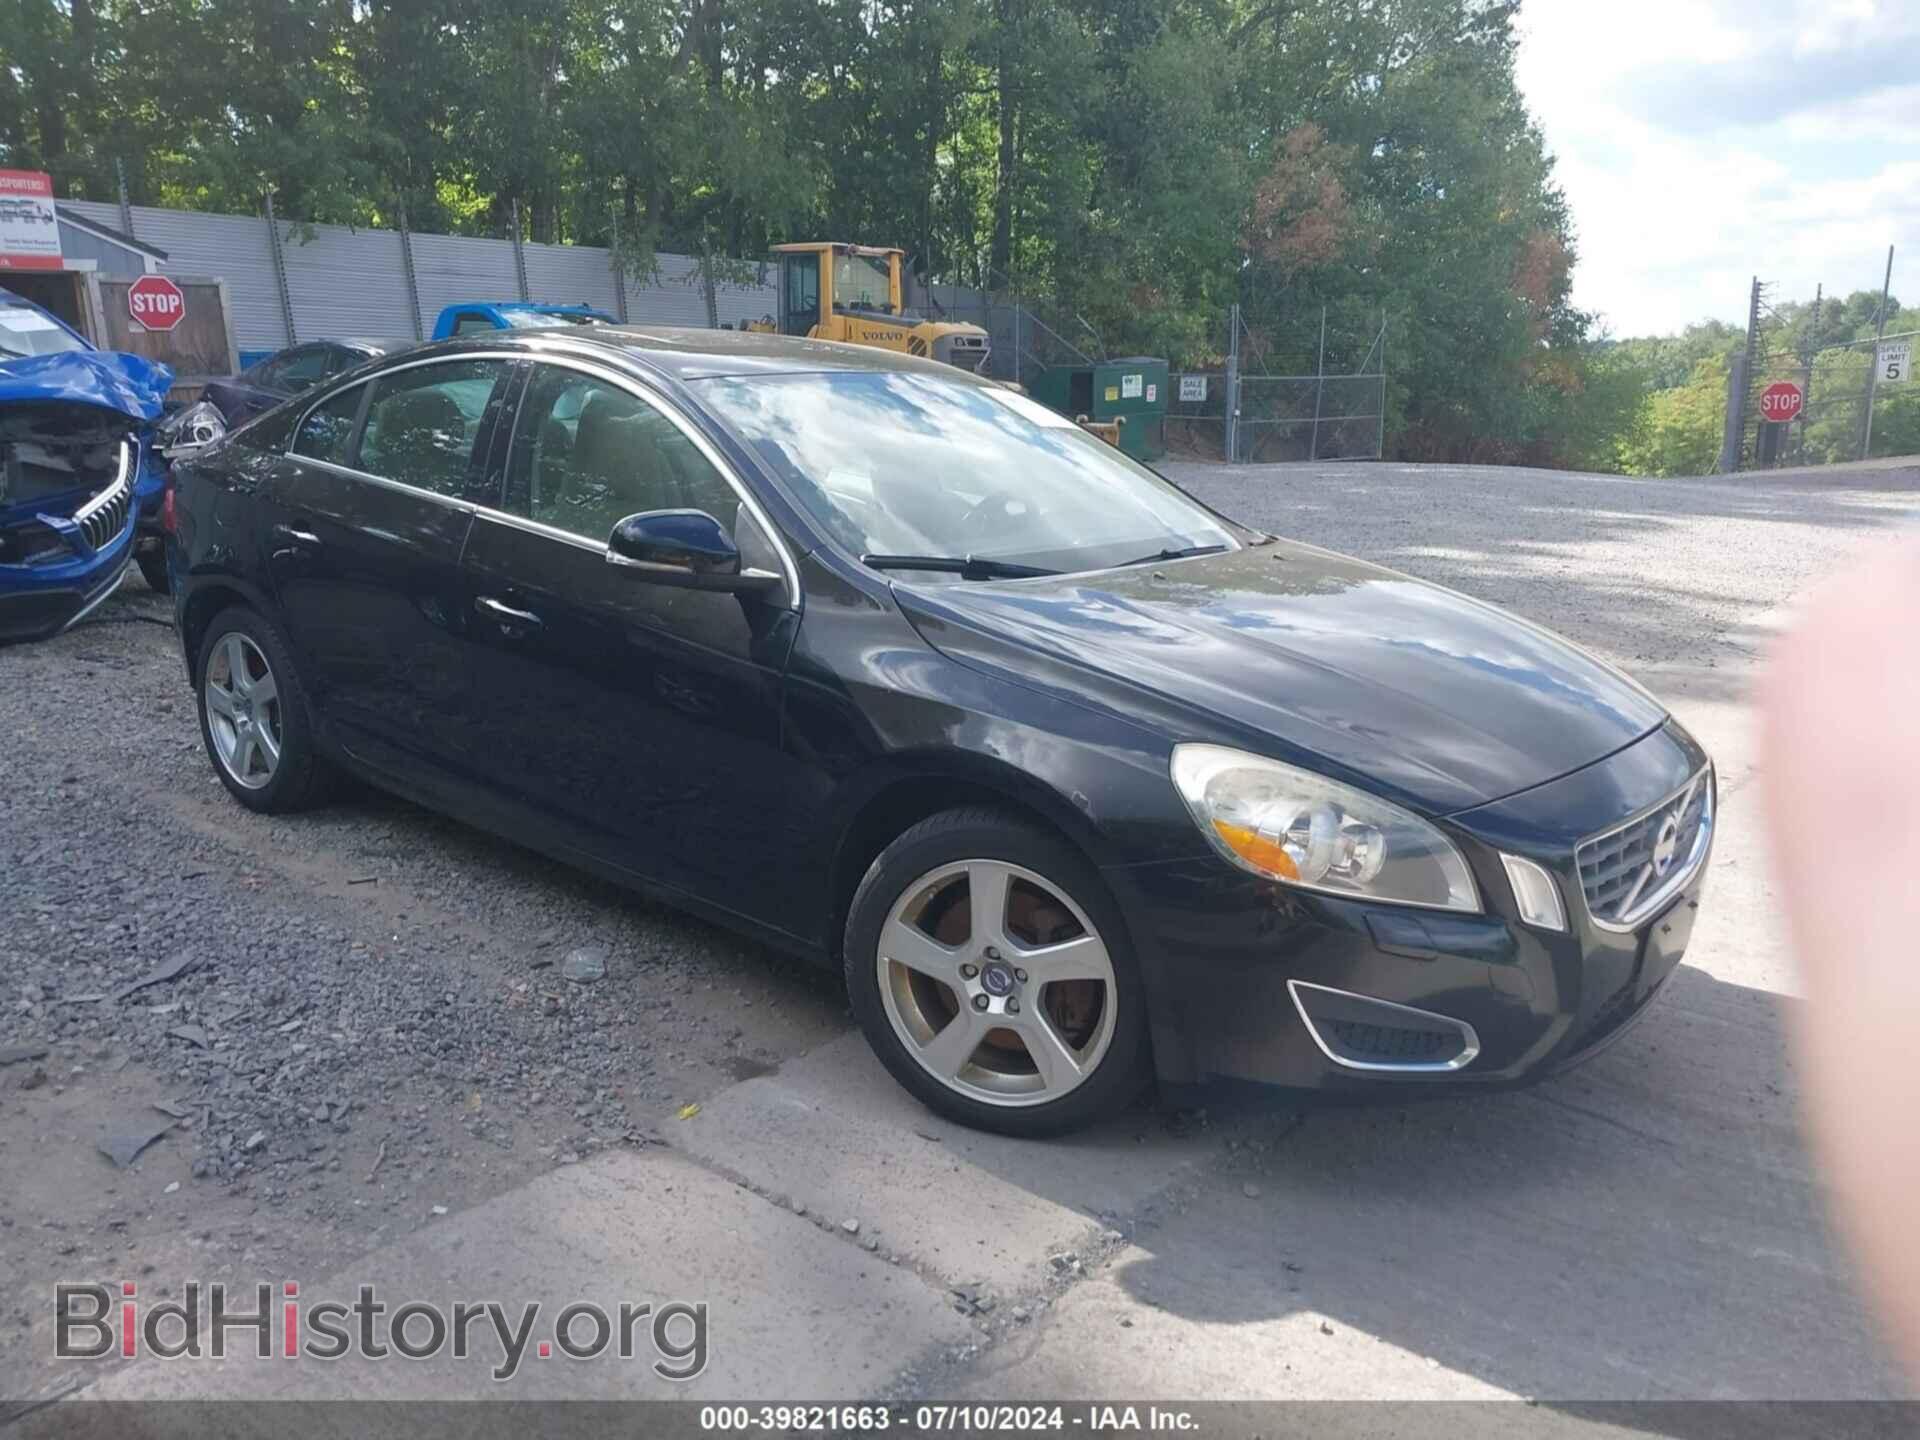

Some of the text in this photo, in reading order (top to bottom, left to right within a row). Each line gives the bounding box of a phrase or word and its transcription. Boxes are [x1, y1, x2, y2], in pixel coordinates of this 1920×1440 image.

[133, 293, 180, 313] STOP
[862, 332, 903, 341] VOLVO
[1881, 353, 1906, 362] LIMIT
[1886, 362, 1901, 380] 5
[1762, 394, 1800, 411] STOP
